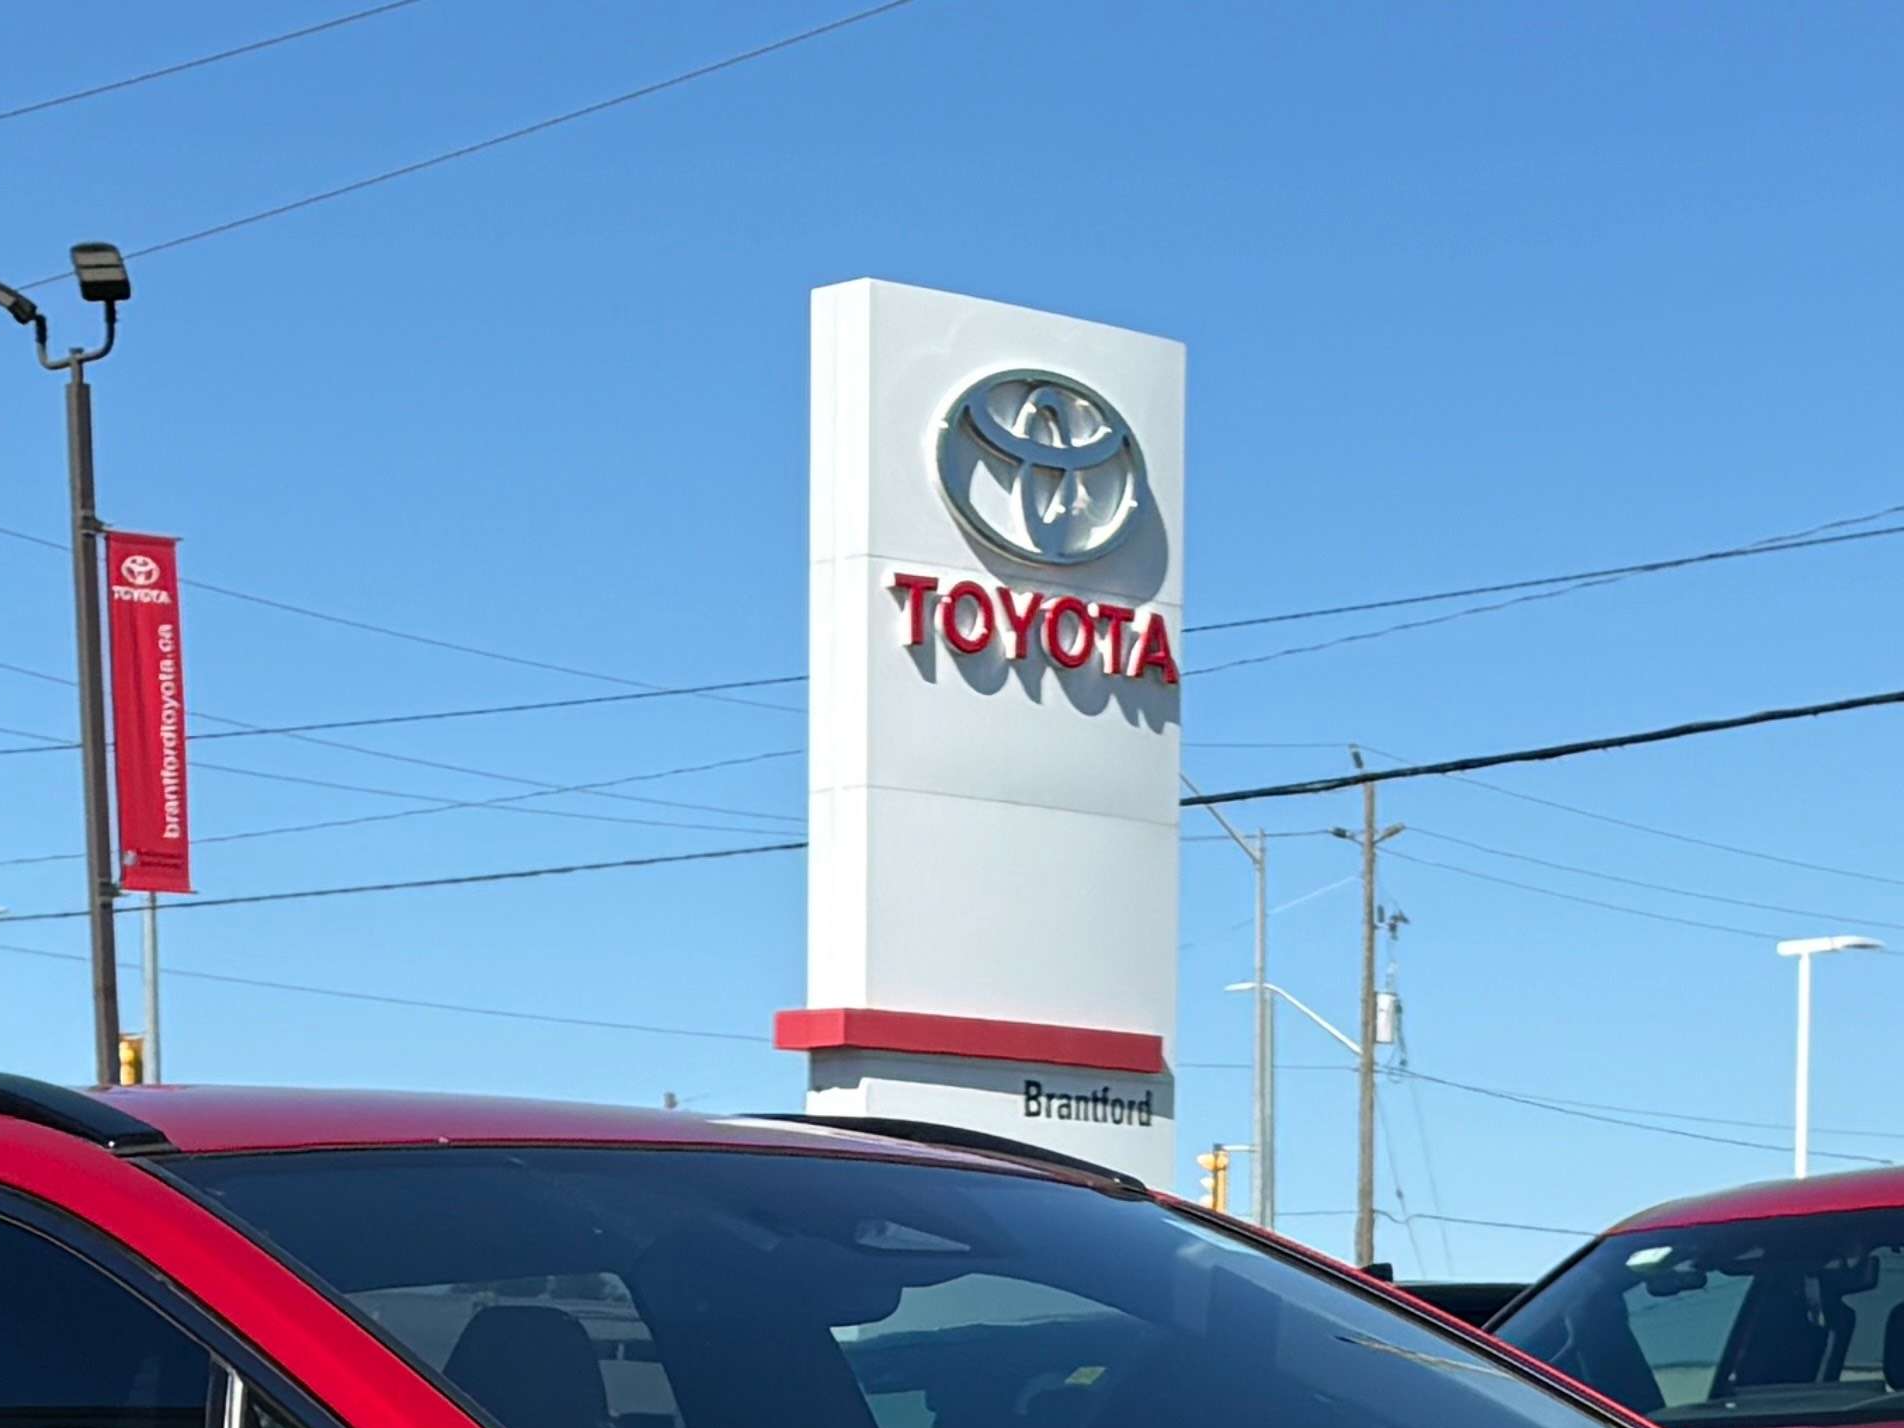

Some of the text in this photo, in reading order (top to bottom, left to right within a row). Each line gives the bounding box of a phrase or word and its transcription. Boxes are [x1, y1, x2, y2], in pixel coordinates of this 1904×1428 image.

[112, 586, 172, 604] TOYOTA
[891, 573, 1179, 685] TOYOTA
[158, 624, 181, 838] brantfordtoyota.ca
[1023, 1079, 1153, 1127] Brantford
